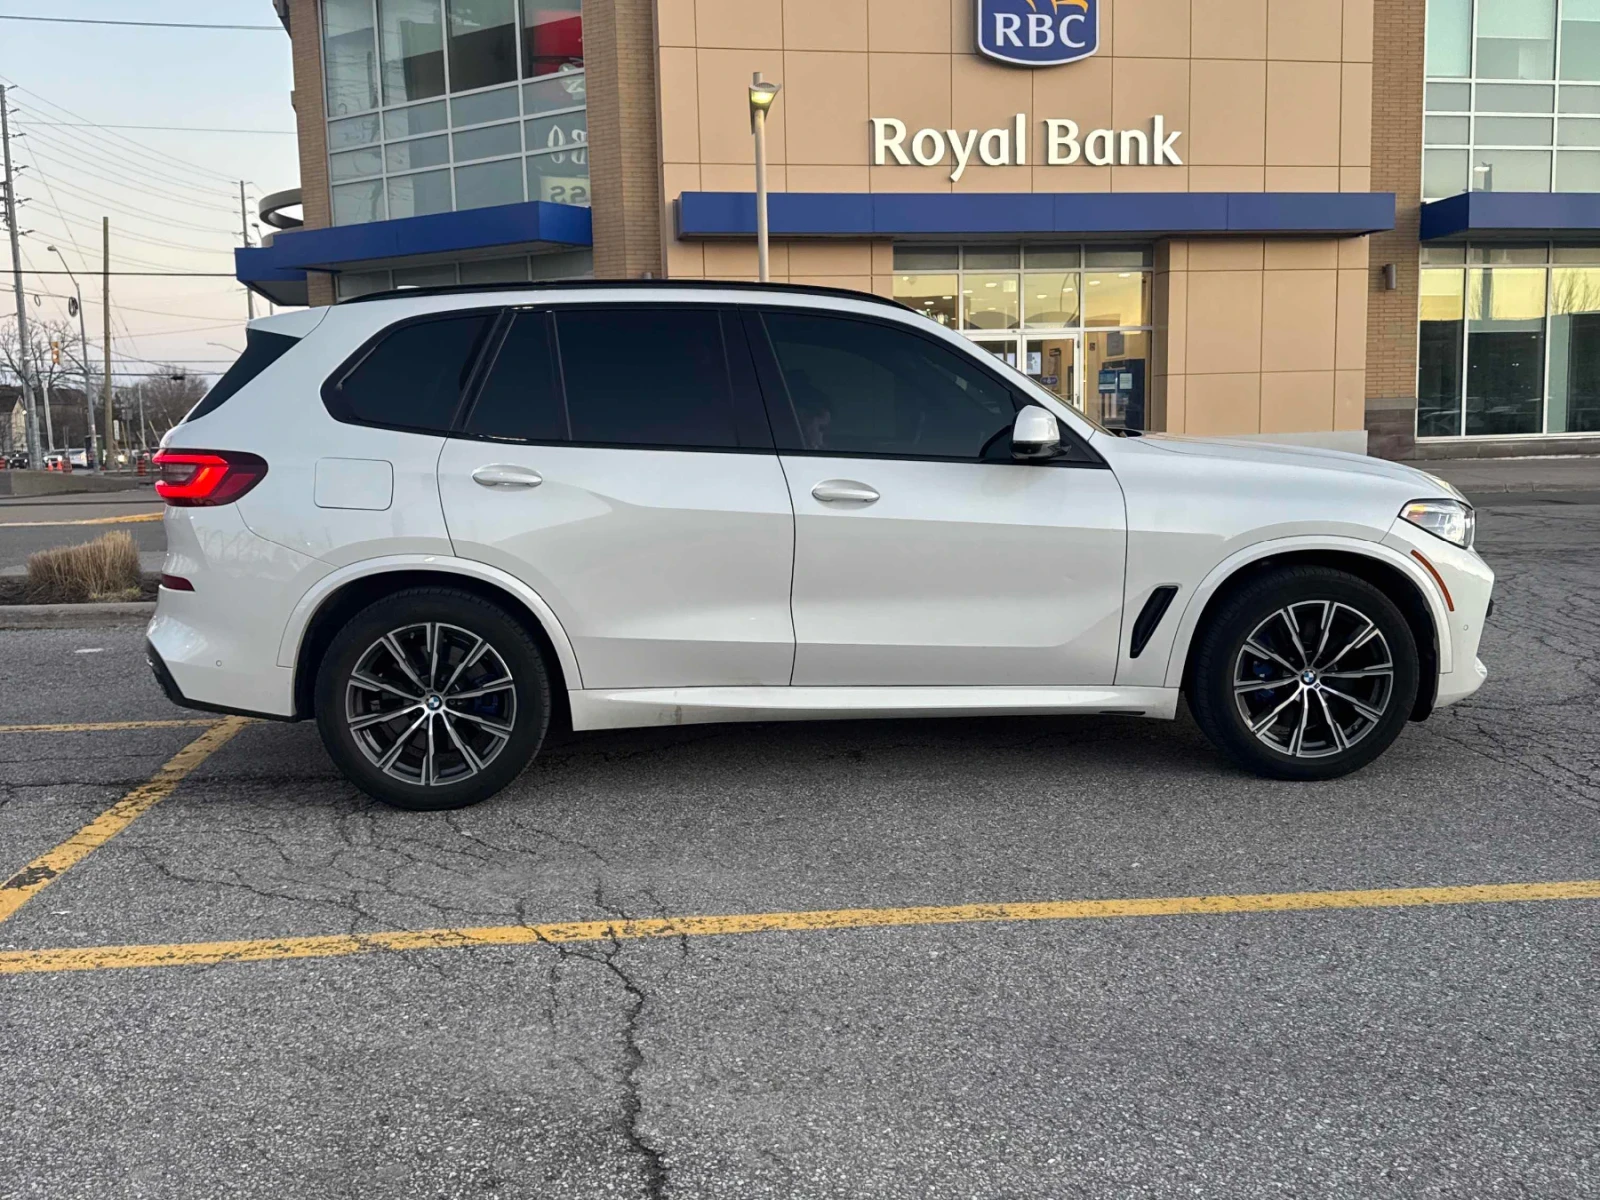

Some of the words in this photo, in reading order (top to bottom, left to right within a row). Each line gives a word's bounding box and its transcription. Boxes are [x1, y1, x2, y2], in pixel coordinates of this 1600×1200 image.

[993, 13, 1086, 48] RBC
[870, 113, 1026, 182] Royal
[1044, 115, 1183, 165] Bank
